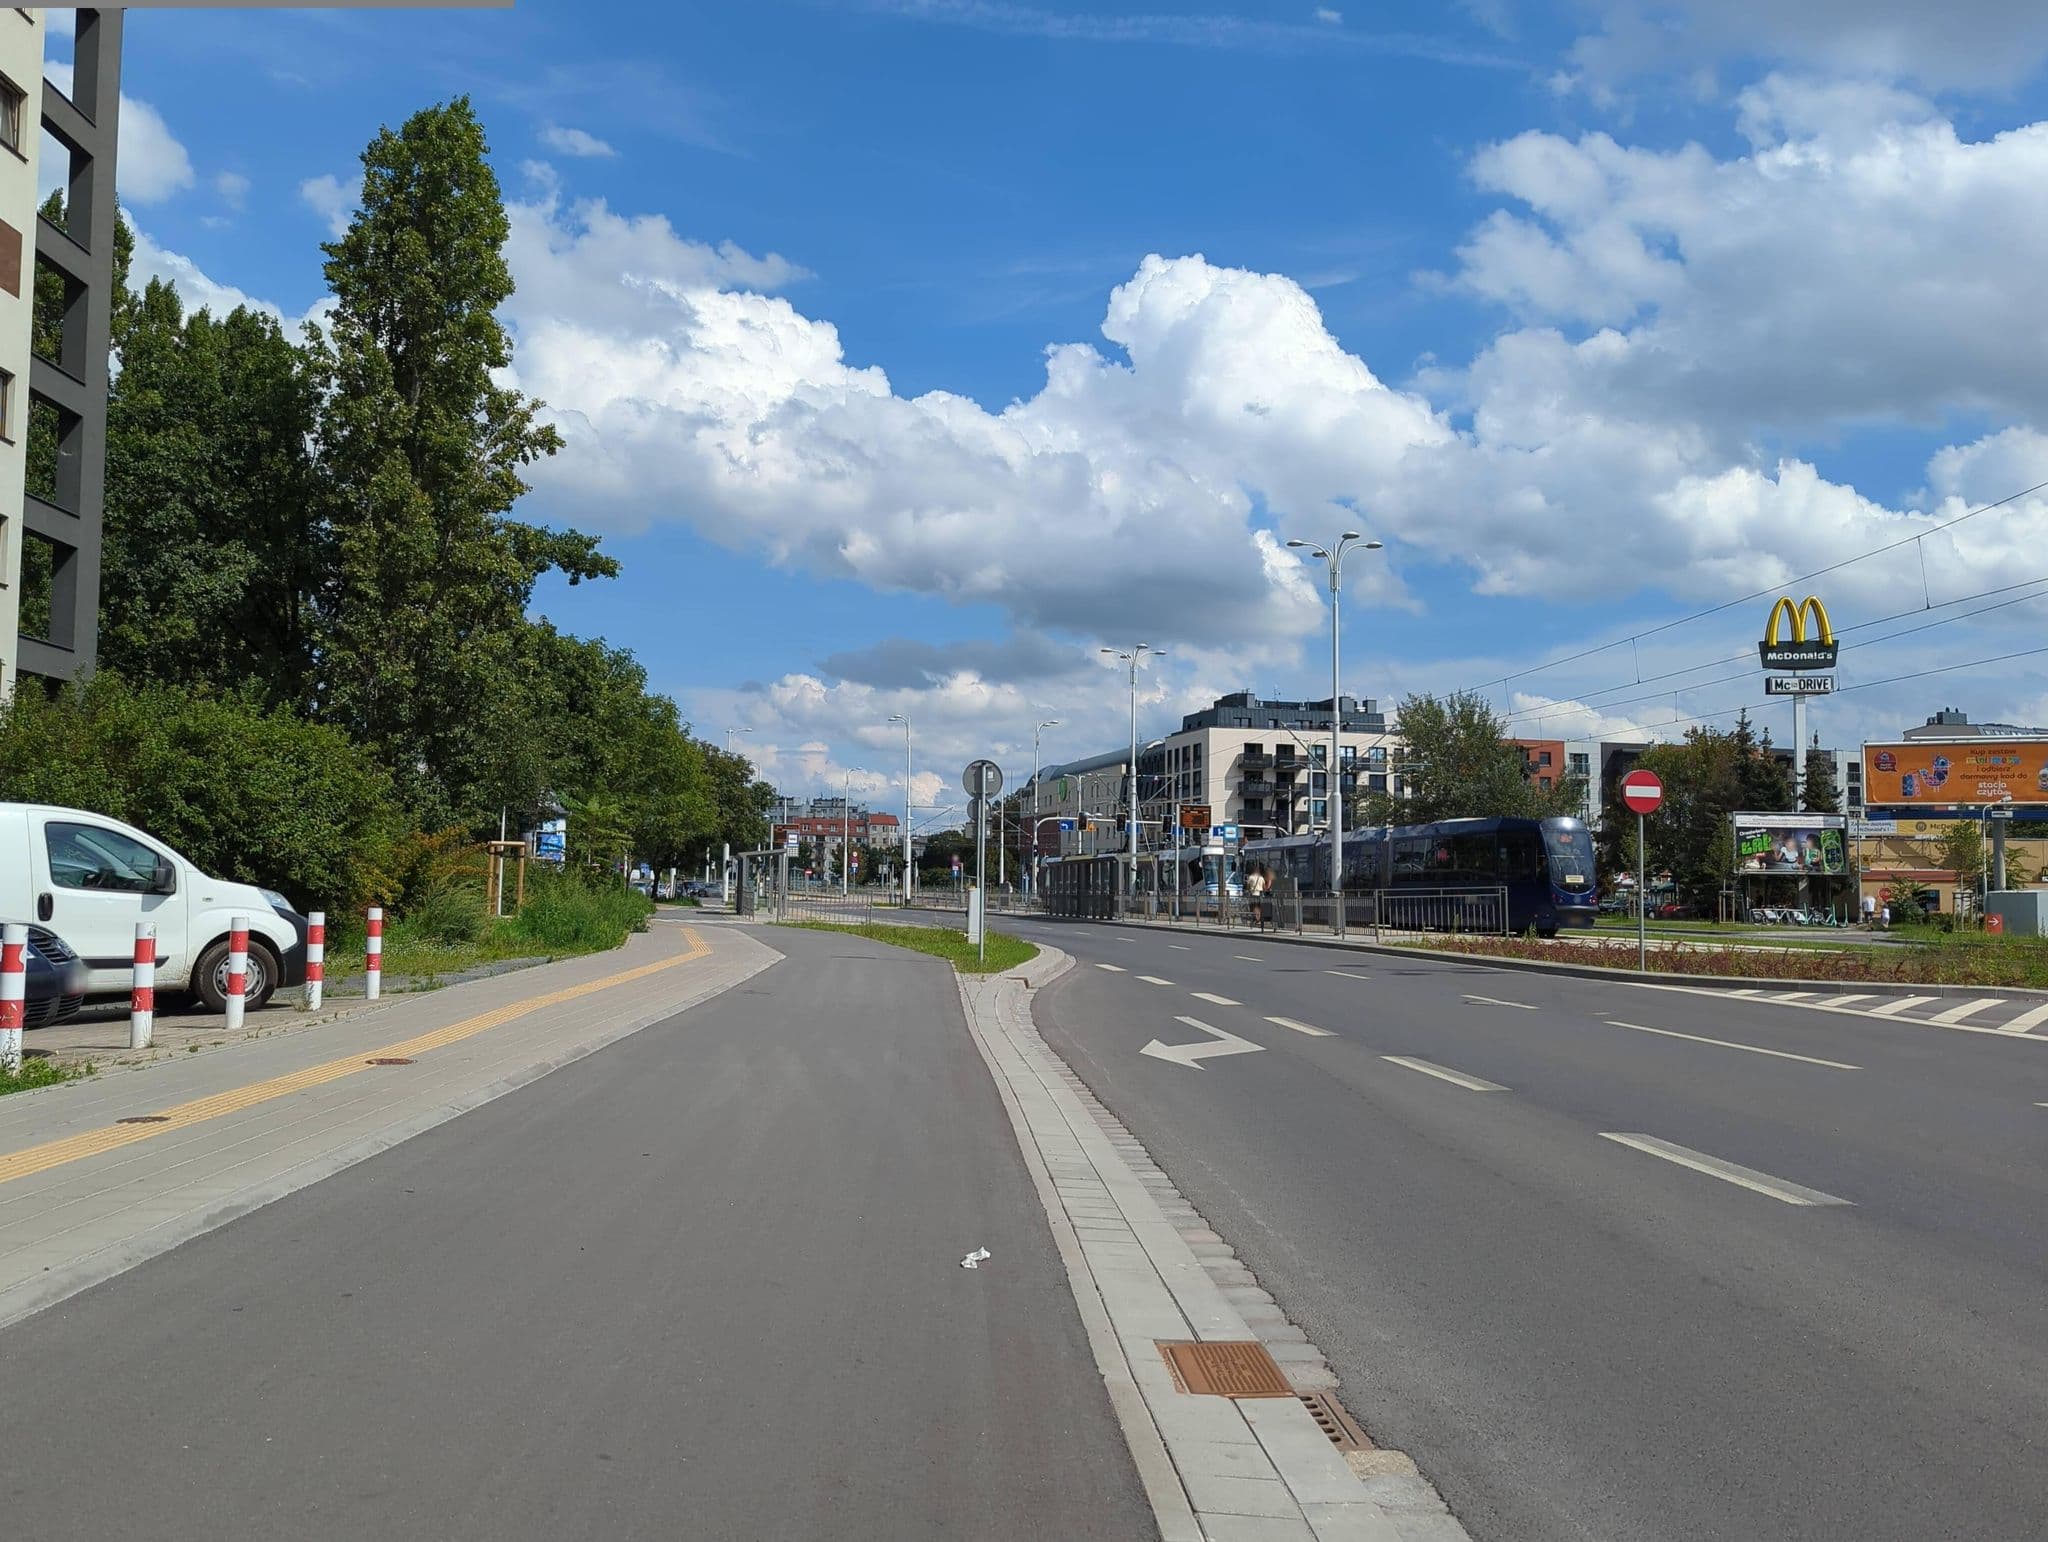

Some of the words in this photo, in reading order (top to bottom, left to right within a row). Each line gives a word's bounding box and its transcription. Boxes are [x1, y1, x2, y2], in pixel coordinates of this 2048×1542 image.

[1767, 652, 1833, 660] McDonald's
[1774, 679, 1791, 690] Mc
[1798, 679, 1829, 690] DRIVE
